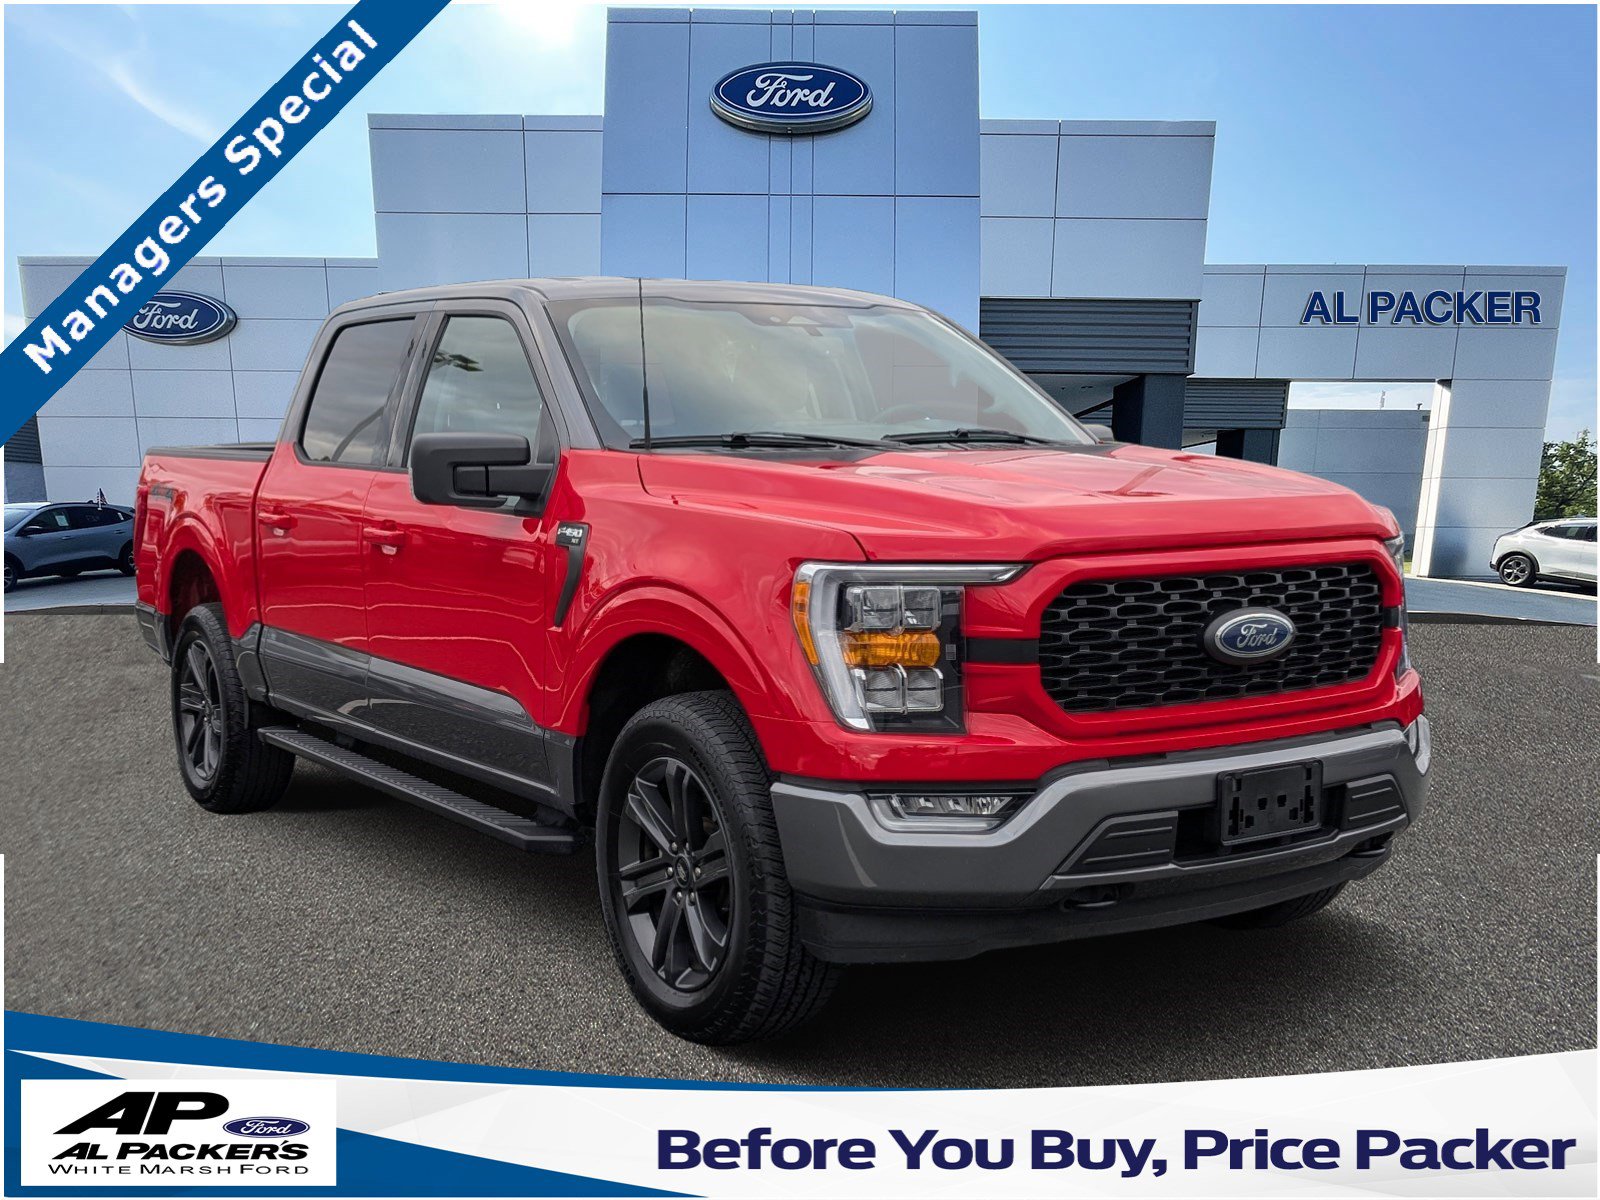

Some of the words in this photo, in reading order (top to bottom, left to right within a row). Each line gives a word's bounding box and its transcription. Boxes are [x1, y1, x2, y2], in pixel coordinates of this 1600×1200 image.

[746, 73, 836, 107] Ford
[133, 301, 199, 329] Ford
[1301, 290, 1359, 325] AL
[1368, 290, 1542, 325] PACKER
[1236, 623, 1278, 648] Ford
